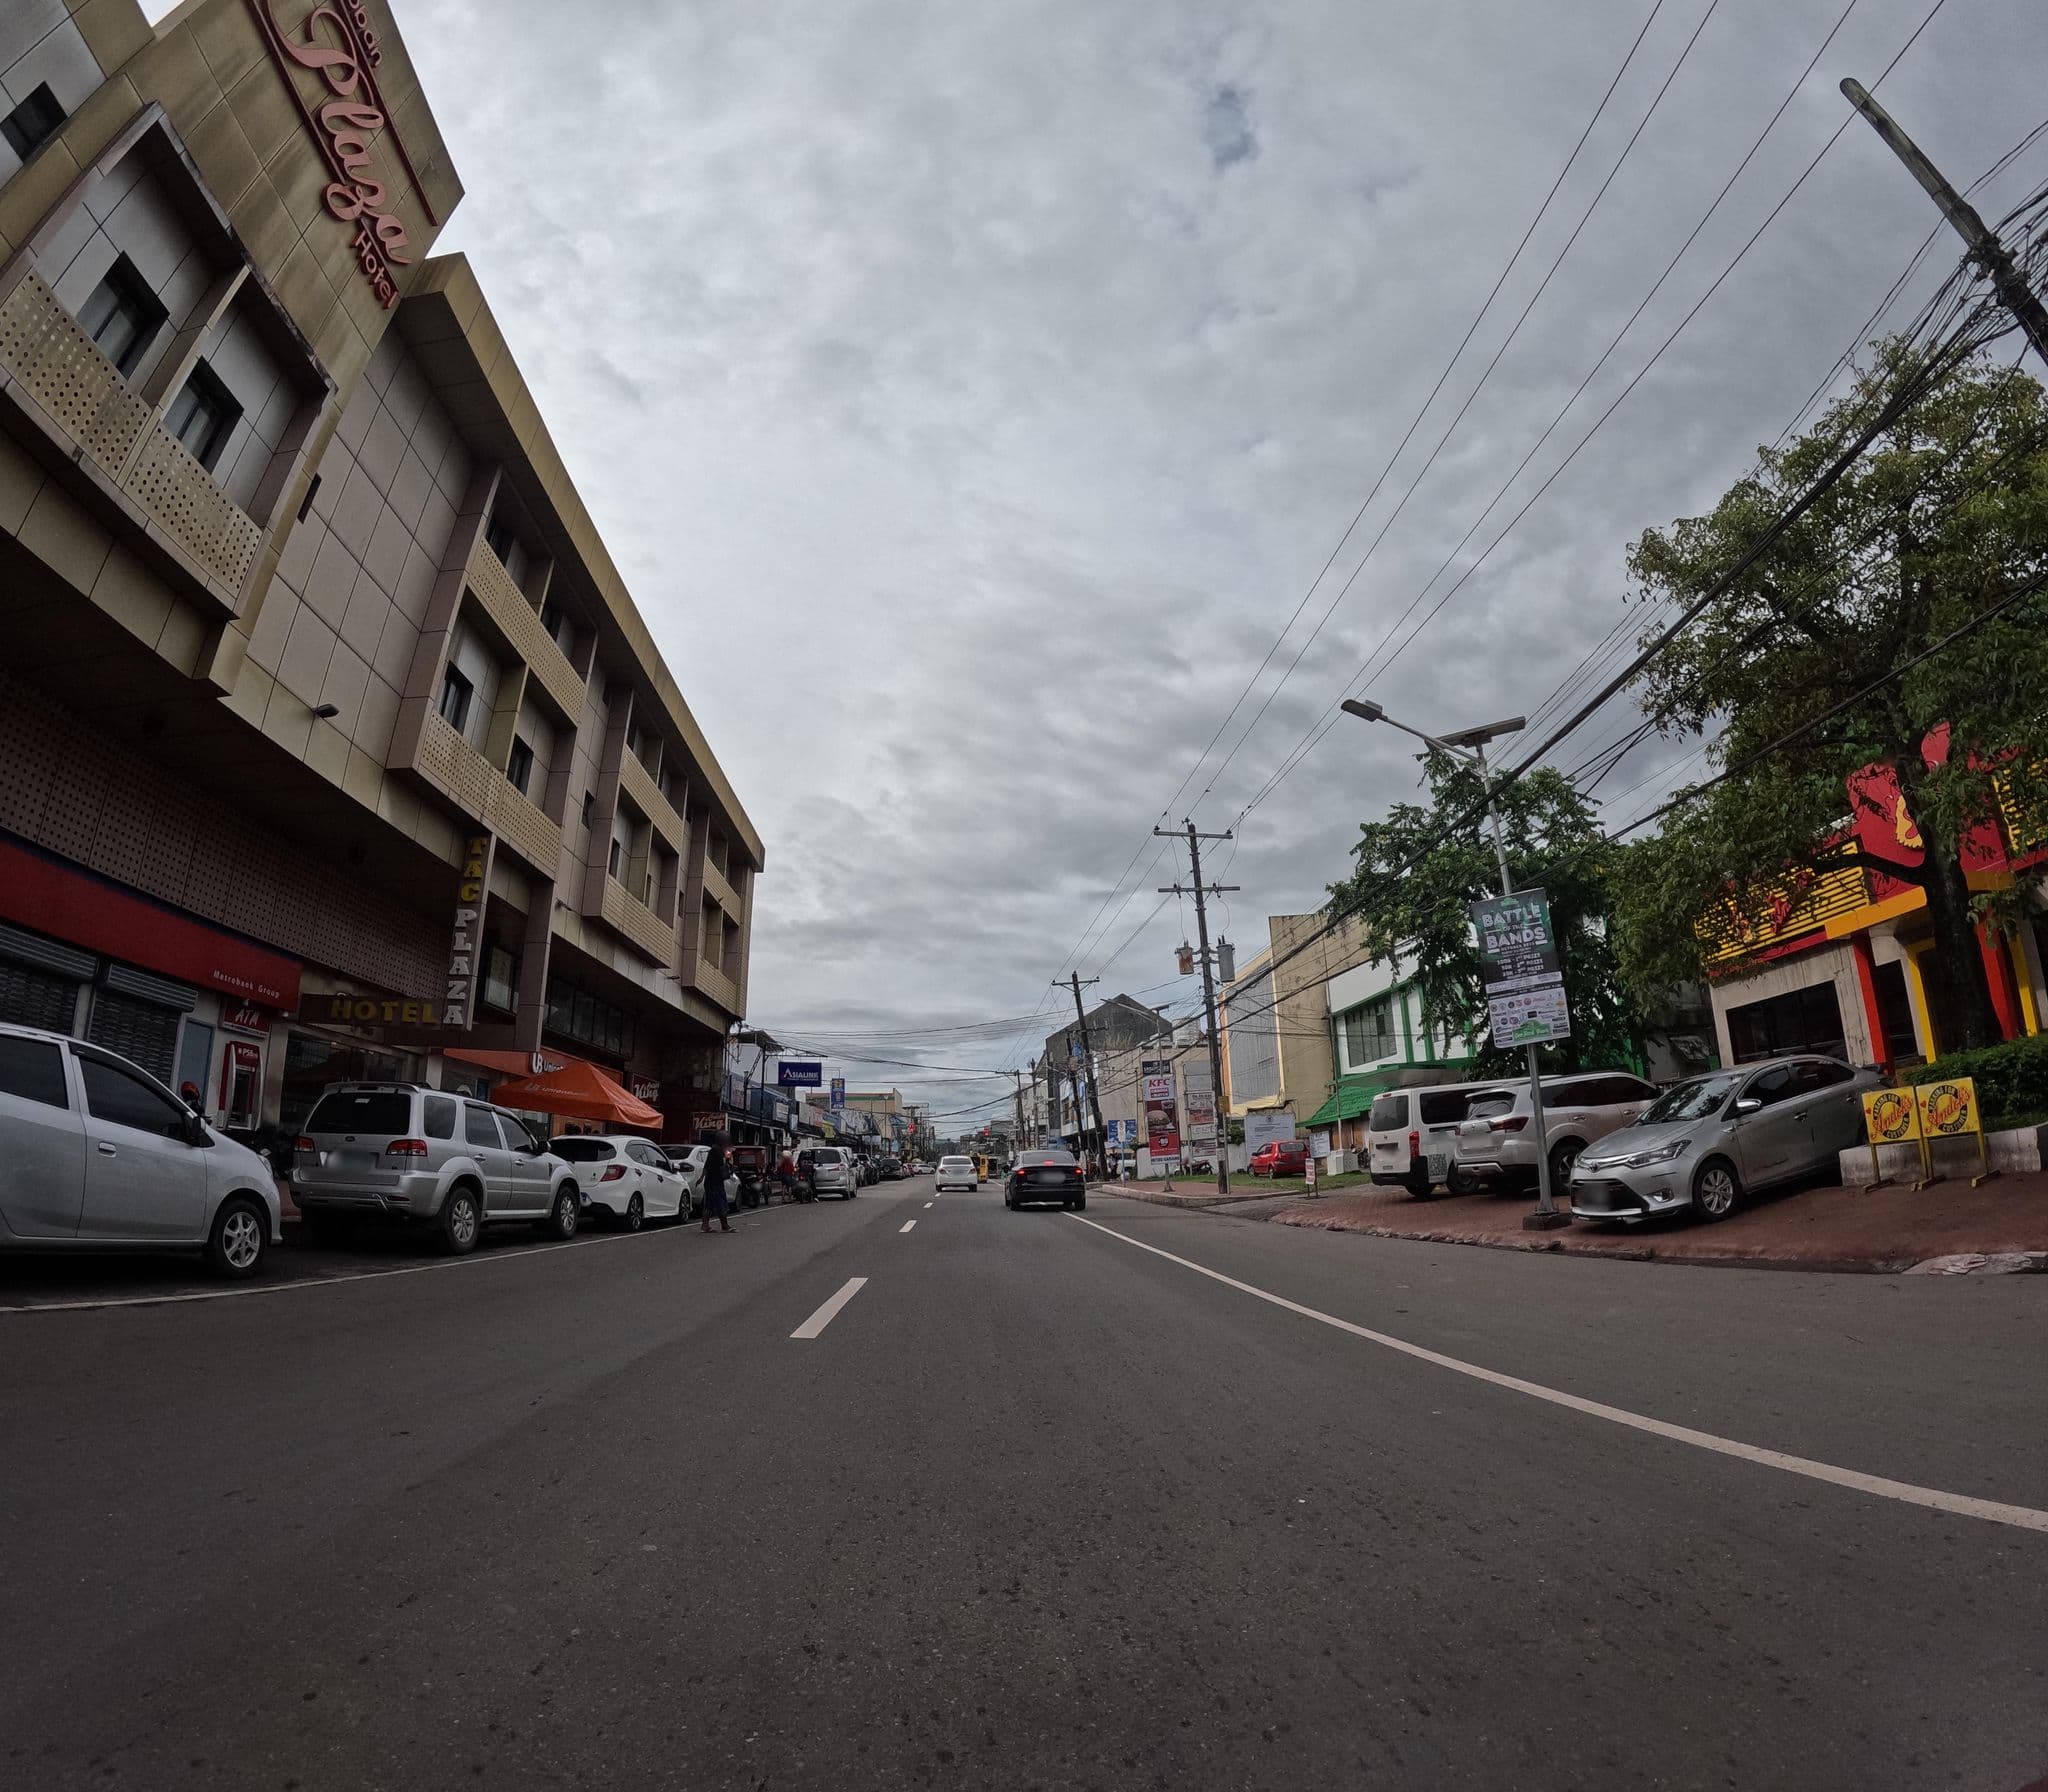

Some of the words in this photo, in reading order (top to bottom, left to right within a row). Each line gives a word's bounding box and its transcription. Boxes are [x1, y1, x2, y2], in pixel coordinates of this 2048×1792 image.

[264, 0, 414, 265] Plaza
[352, 231, 400, 310] Hotel
[459, 836, 487, 902] TAC
[1481, 902, 1542, 928] BATTLE
[1486, 926, 1546, 949] BANDS
[442, 908, 478, 1025] PLAZA
[213, 969, 255, 990] Metrobank
[257, 983, 280, 999] Group
[234, 1008, 261, 1027] ATM
[329, 998, 440, 1025] HOTEL
[1148, 1078, 1170, 1088] KFC
